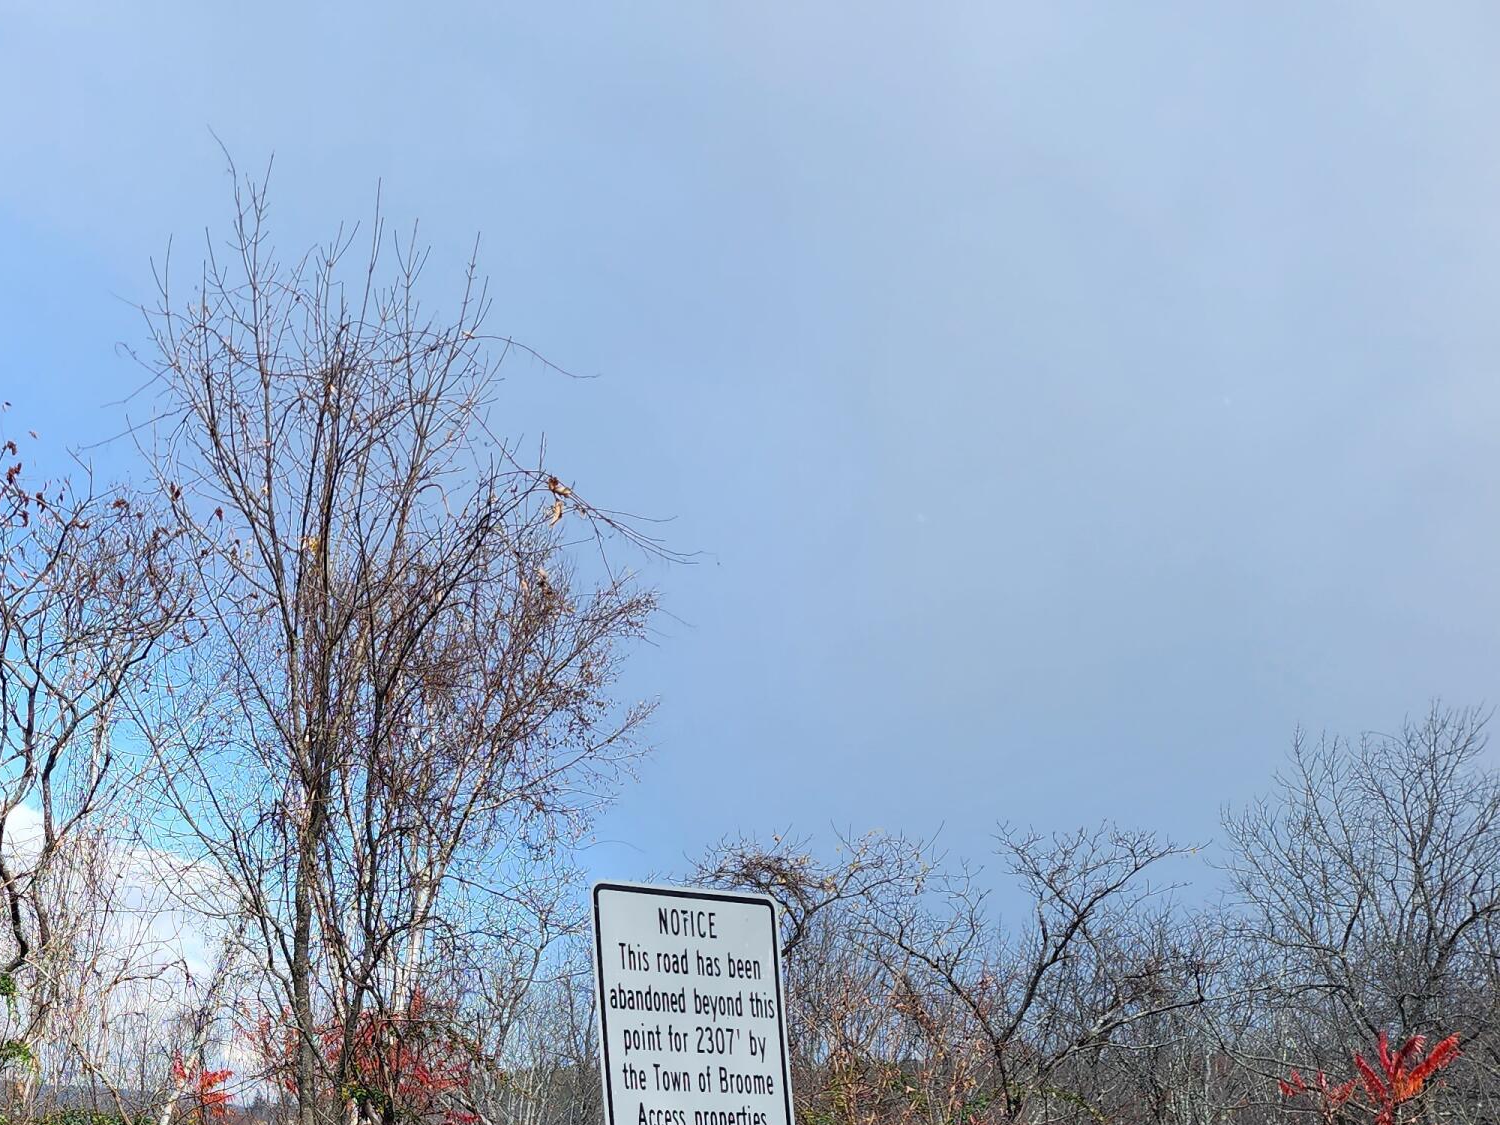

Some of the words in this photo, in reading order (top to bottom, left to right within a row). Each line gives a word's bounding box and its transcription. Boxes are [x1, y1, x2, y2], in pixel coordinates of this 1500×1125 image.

[658, 907, 717, 939] NOTICE
[619, 942, 649, 972] This
[657, 948, 688, 975] road
[696, 950, 721, 977] has
[728, 952, 761, 980] been
[610, 983, 685, 1014] abandoned
[694, 988, 743, 1022] beyond
[750, 992, 775, 1019] this
[623, 1023, 662, 1056] point
[668, 1025, 688, 1052] for
[749, 1030, 766, 1063] by
[622, 1063, 646, 1090] the
[653, 1063, 691, 1092] Town
[699, 1066, 711, 1093] of
[719, 1067, 774, 1095] Broome
